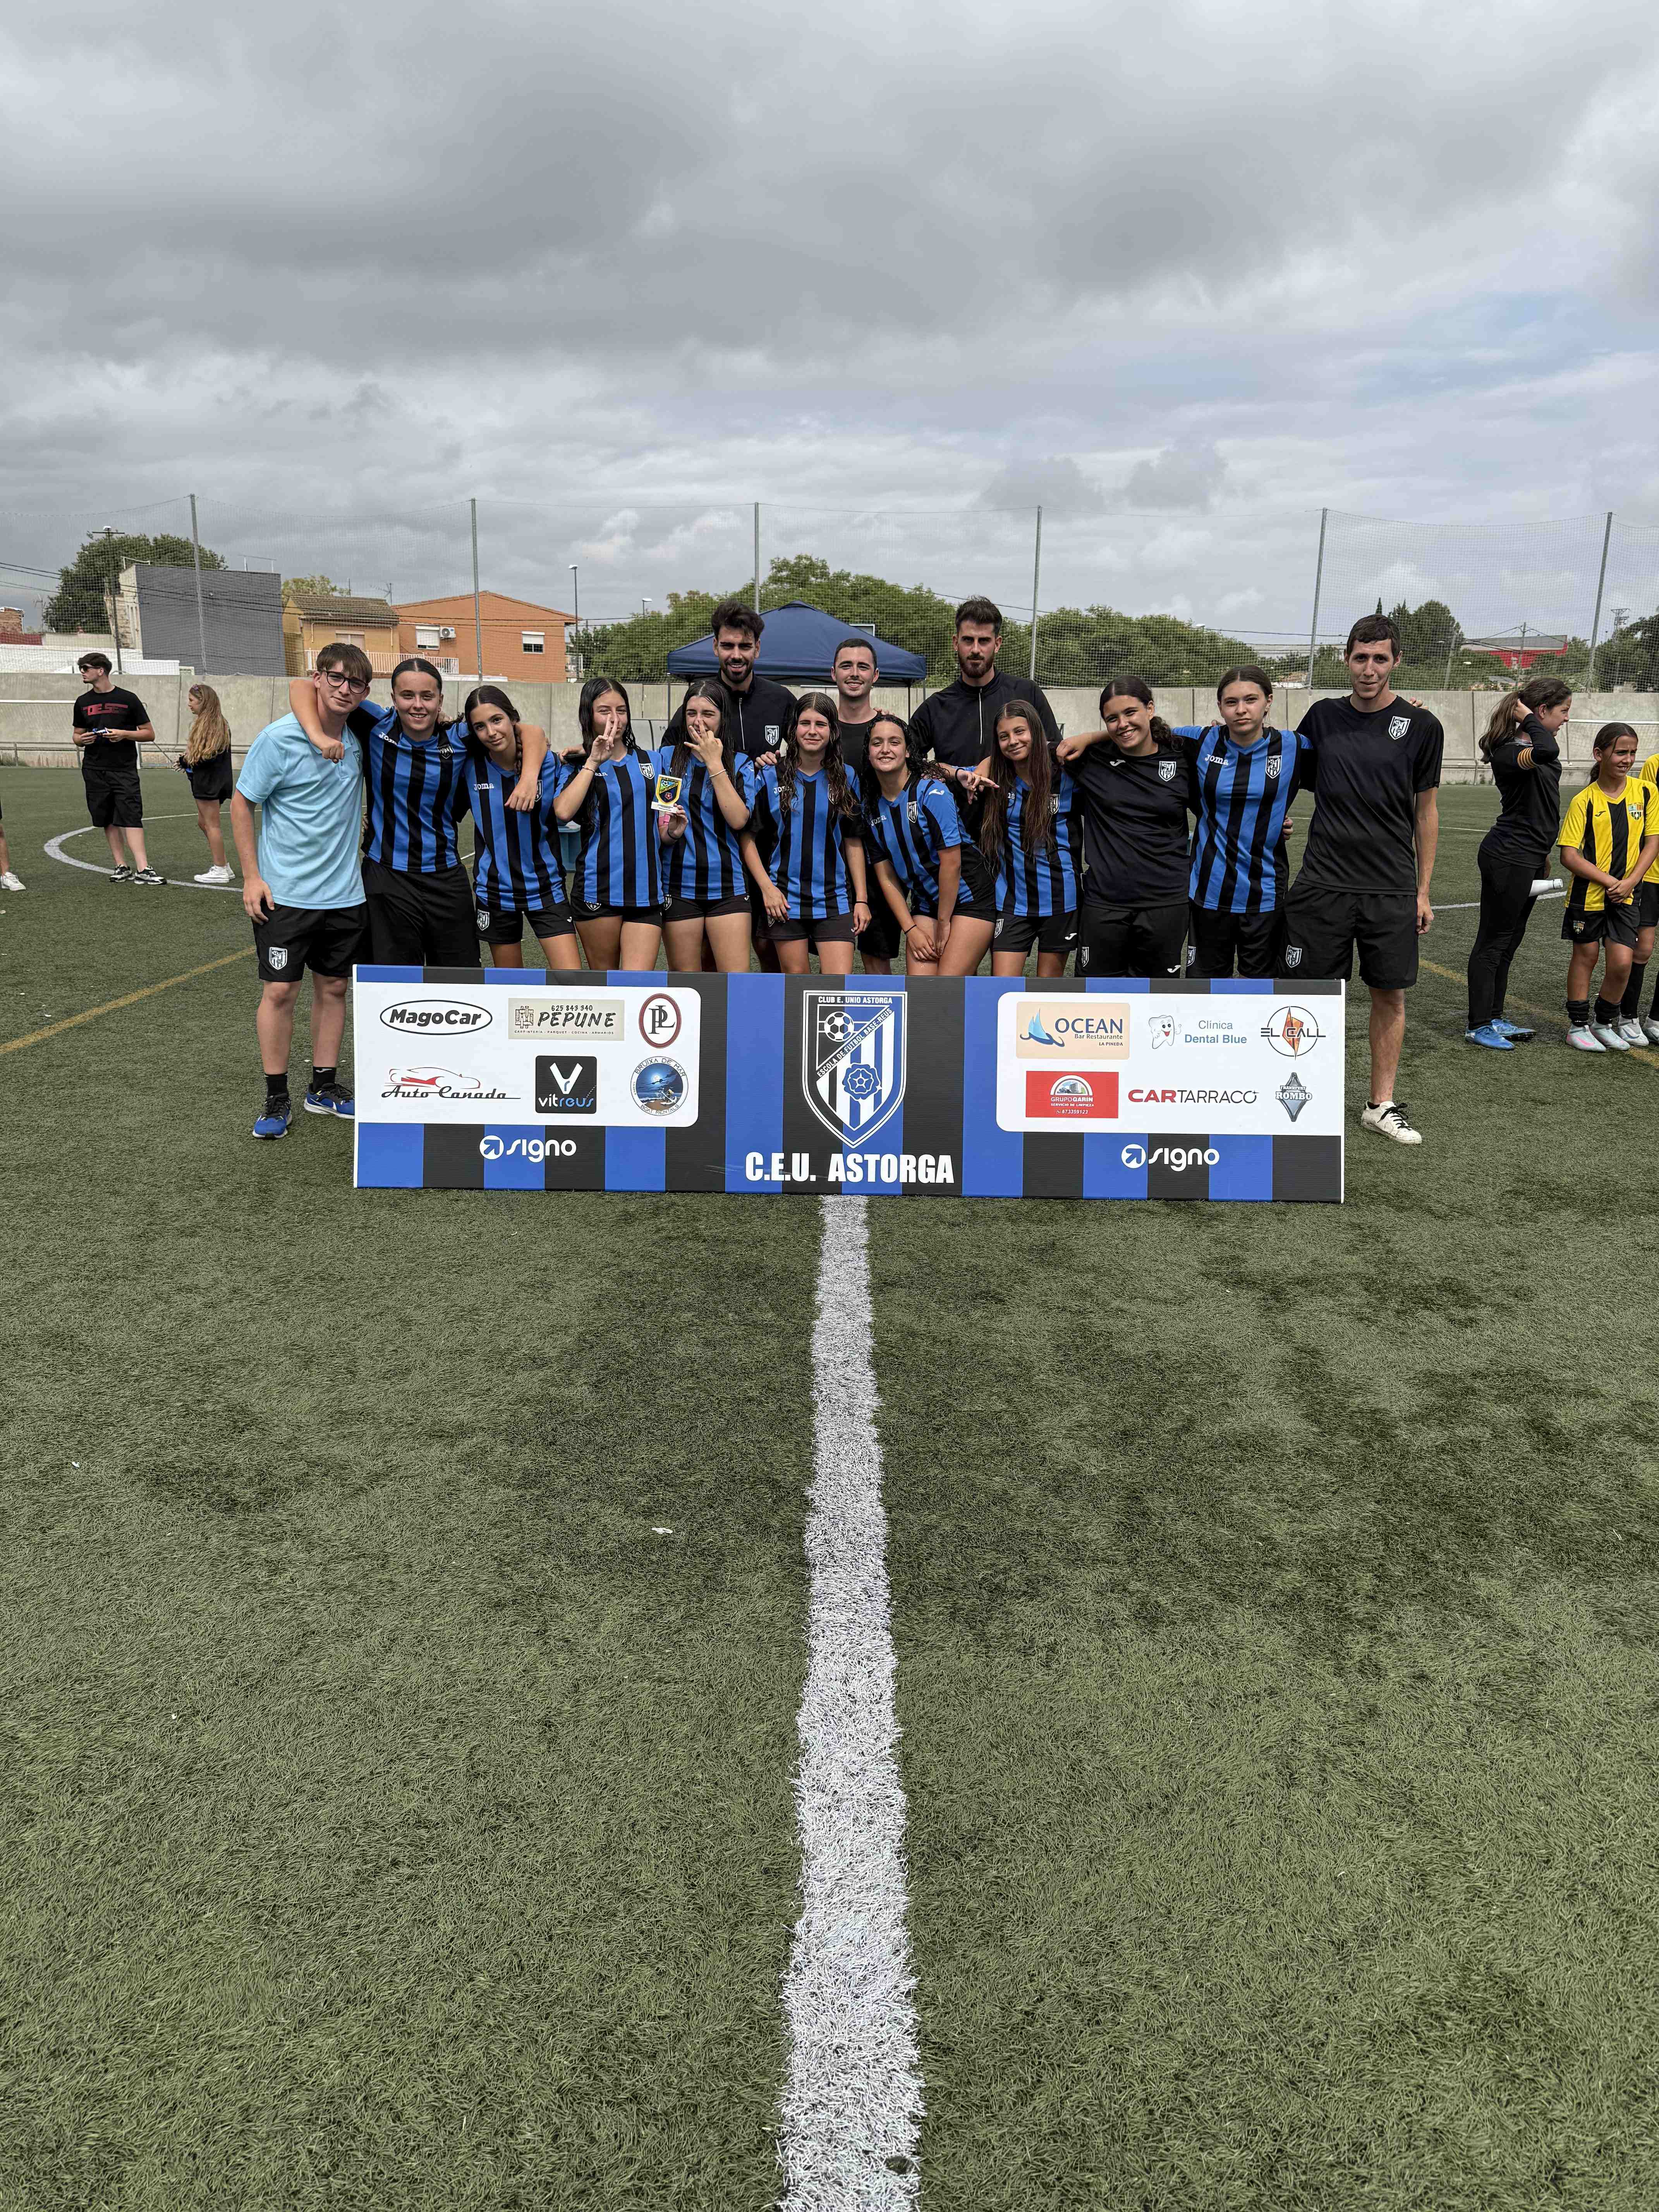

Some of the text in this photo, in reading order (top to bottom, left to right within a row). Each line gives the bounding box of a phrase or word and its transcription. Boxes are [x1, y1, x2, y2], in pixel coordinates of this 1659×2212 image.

[1205, 754, 1229, 766] Joma
[474, 783, 495, 791] Joma
[389, 1009, 482, 1027] MagoCar
[537, 1012, 617, 1028] PEPUNE
[1198, 1020, 1233, 1029] Clínica
[1054, 1018, 1123, 1034] OCEAN
[1261, 1028, 1326, 1037] EL CALL
[817, 1008, 893, 1077] ESCOLA DE FUTBOL BASE-REUS
[1185, 1034, 1247, 1043] Dental Blue
[673, 1063, 685, 1077] MAR
[381, 1085, 521, 1099] Auto Canada
[1276, 1091, 1312, 1101] ROMBO
[538, 1094, 595, 1107] vitreus
[506, 1139, 577, 1163] signo
[1148, 1147, 1220, 1172] signo
[745, 1151, 954, 1184] C.E.U. ASTORGA
